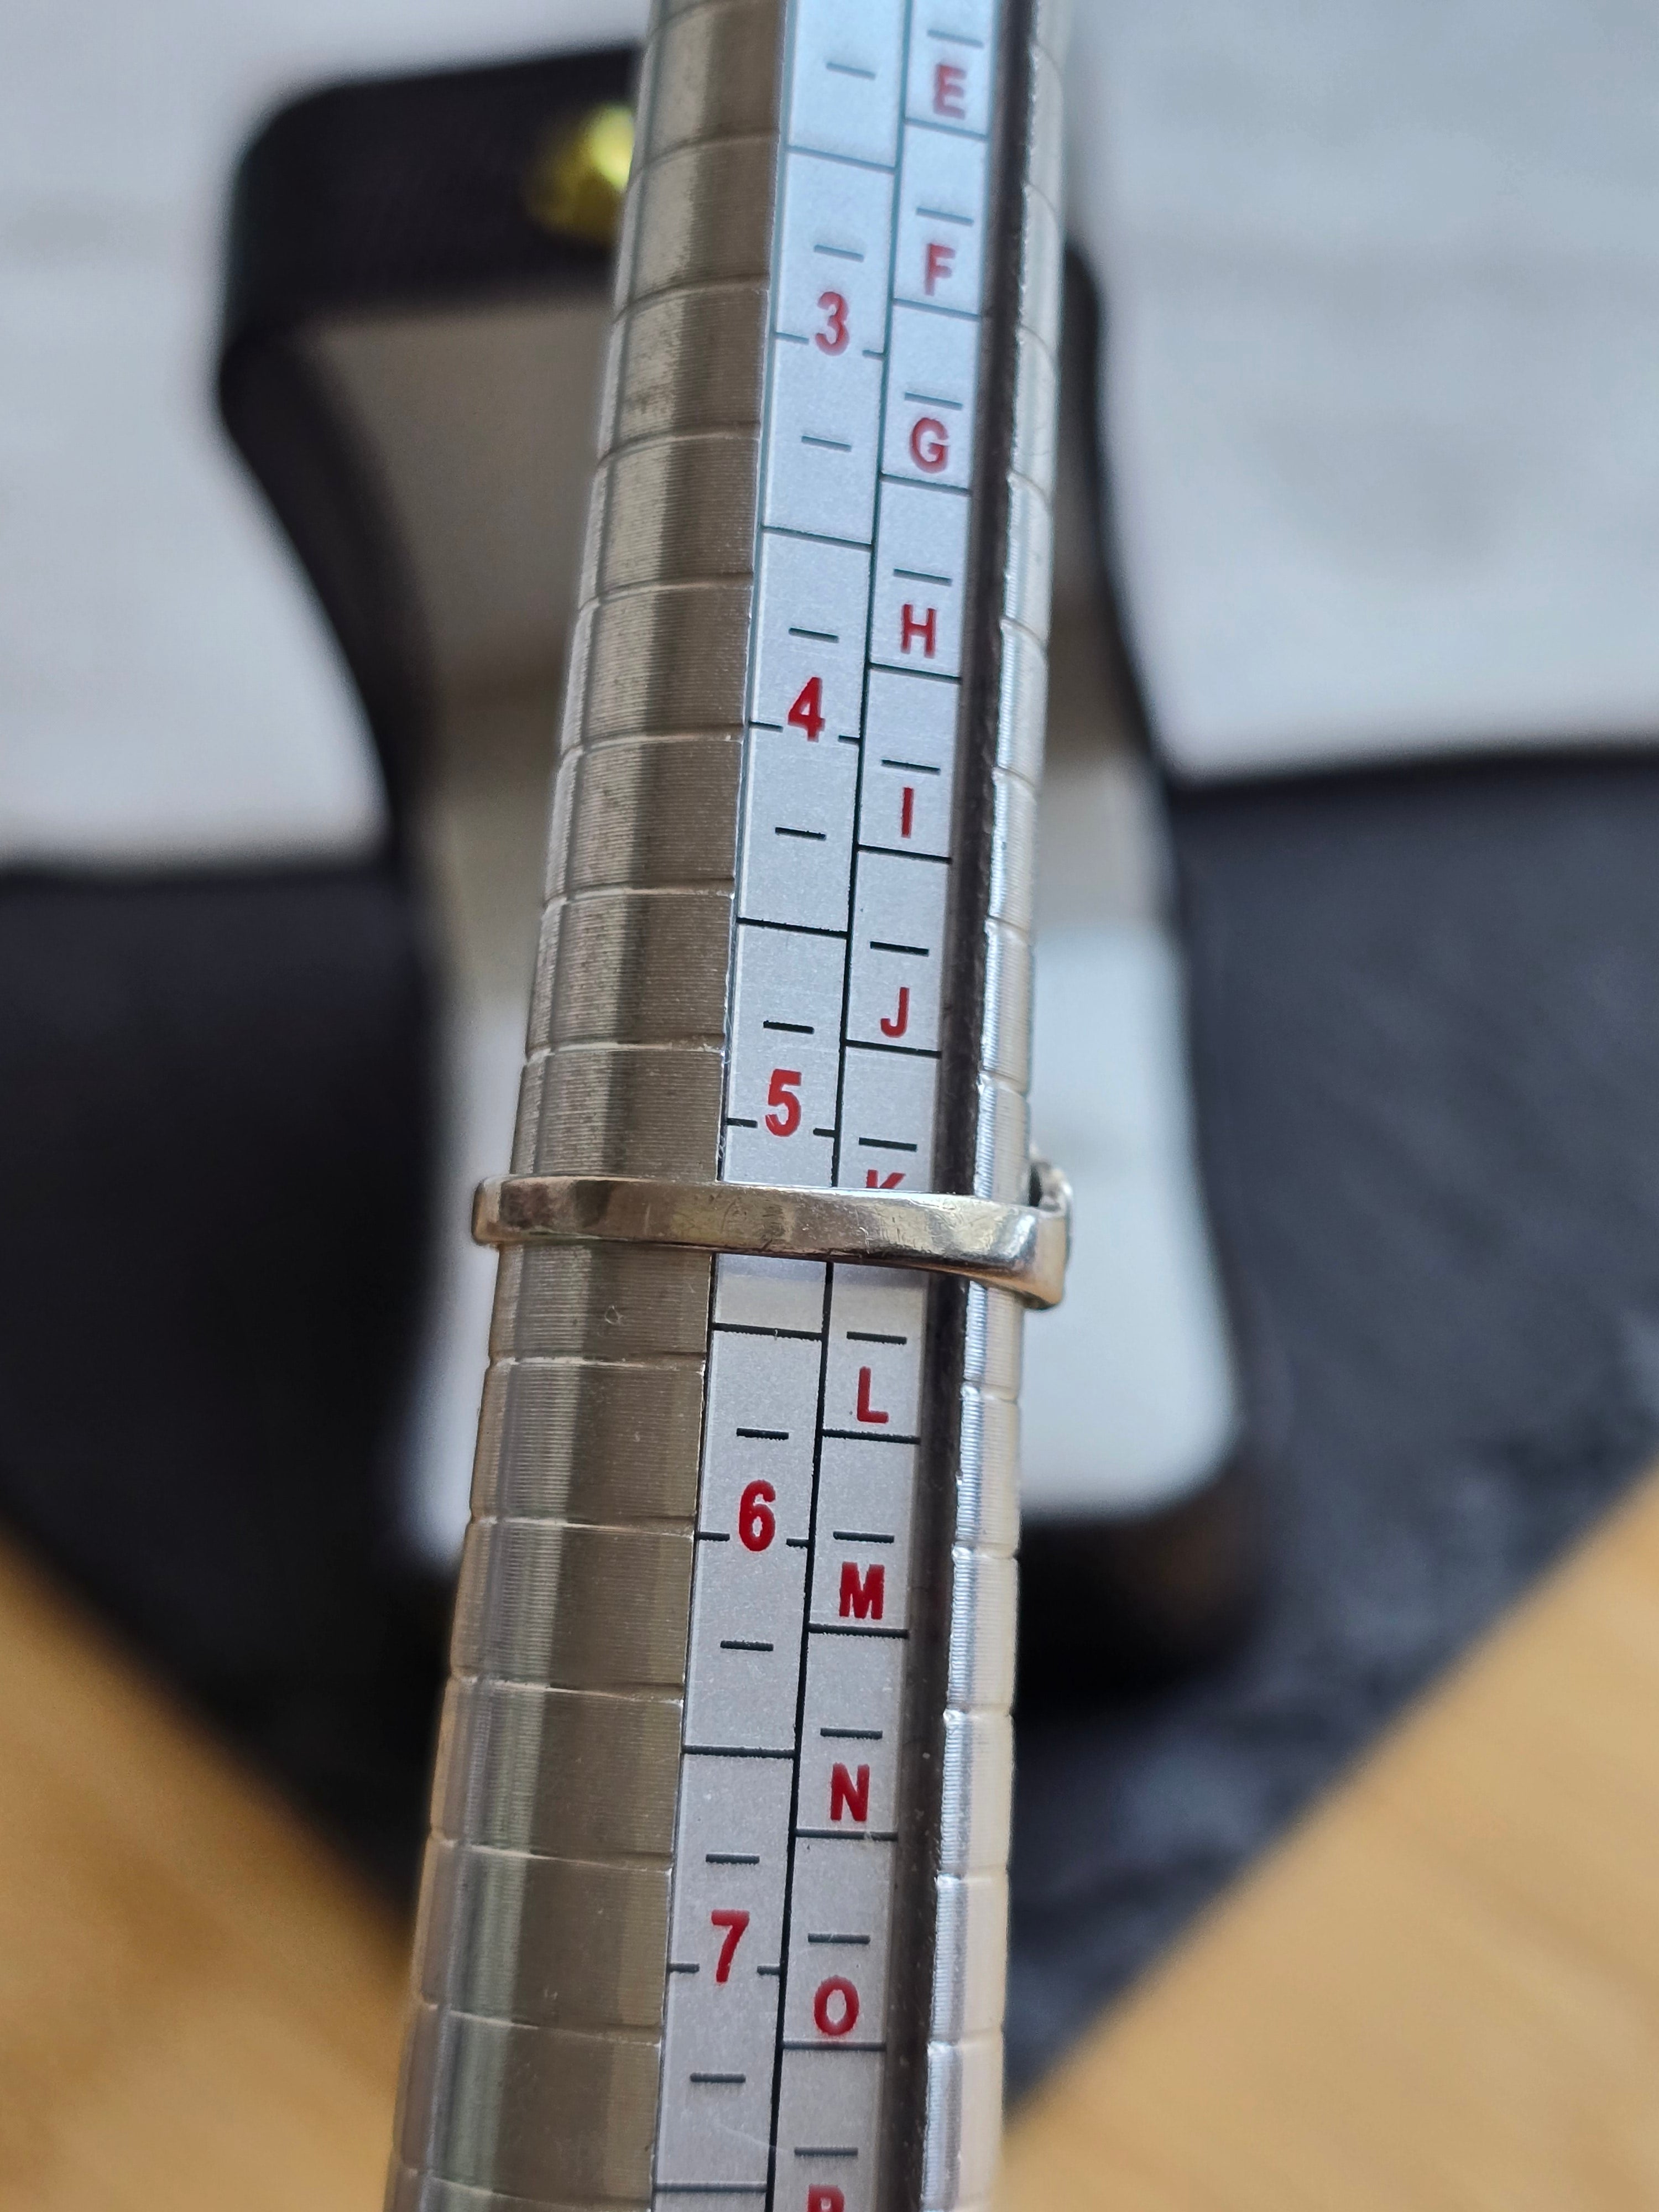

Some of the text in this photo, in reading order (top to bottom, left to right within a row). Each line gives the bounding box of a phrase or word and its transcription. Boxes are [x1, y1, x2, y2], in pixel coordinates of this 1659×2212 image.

[933, 63, 966, 118] E
[925, 242, 955, 295] F
[816, 291, 848, 355] 3
[911, 418, 948, 472] G
[901, 603, 936, 658] H
[787, 676, 824, 741] 4
[901, 787, 914, 838] I
[880, 987, 909, 1038] J
[765, 1068, 801, 1137] 5
[857, 1366, 889, 1424] L
[738, 1479, 775, 1552] 6
[839, 1562, 884, 1620] M
[831, 1762, 870, 1822] N
[711, 1910, 749, 1984] 7
[813, 1976, 859, 2037] O
